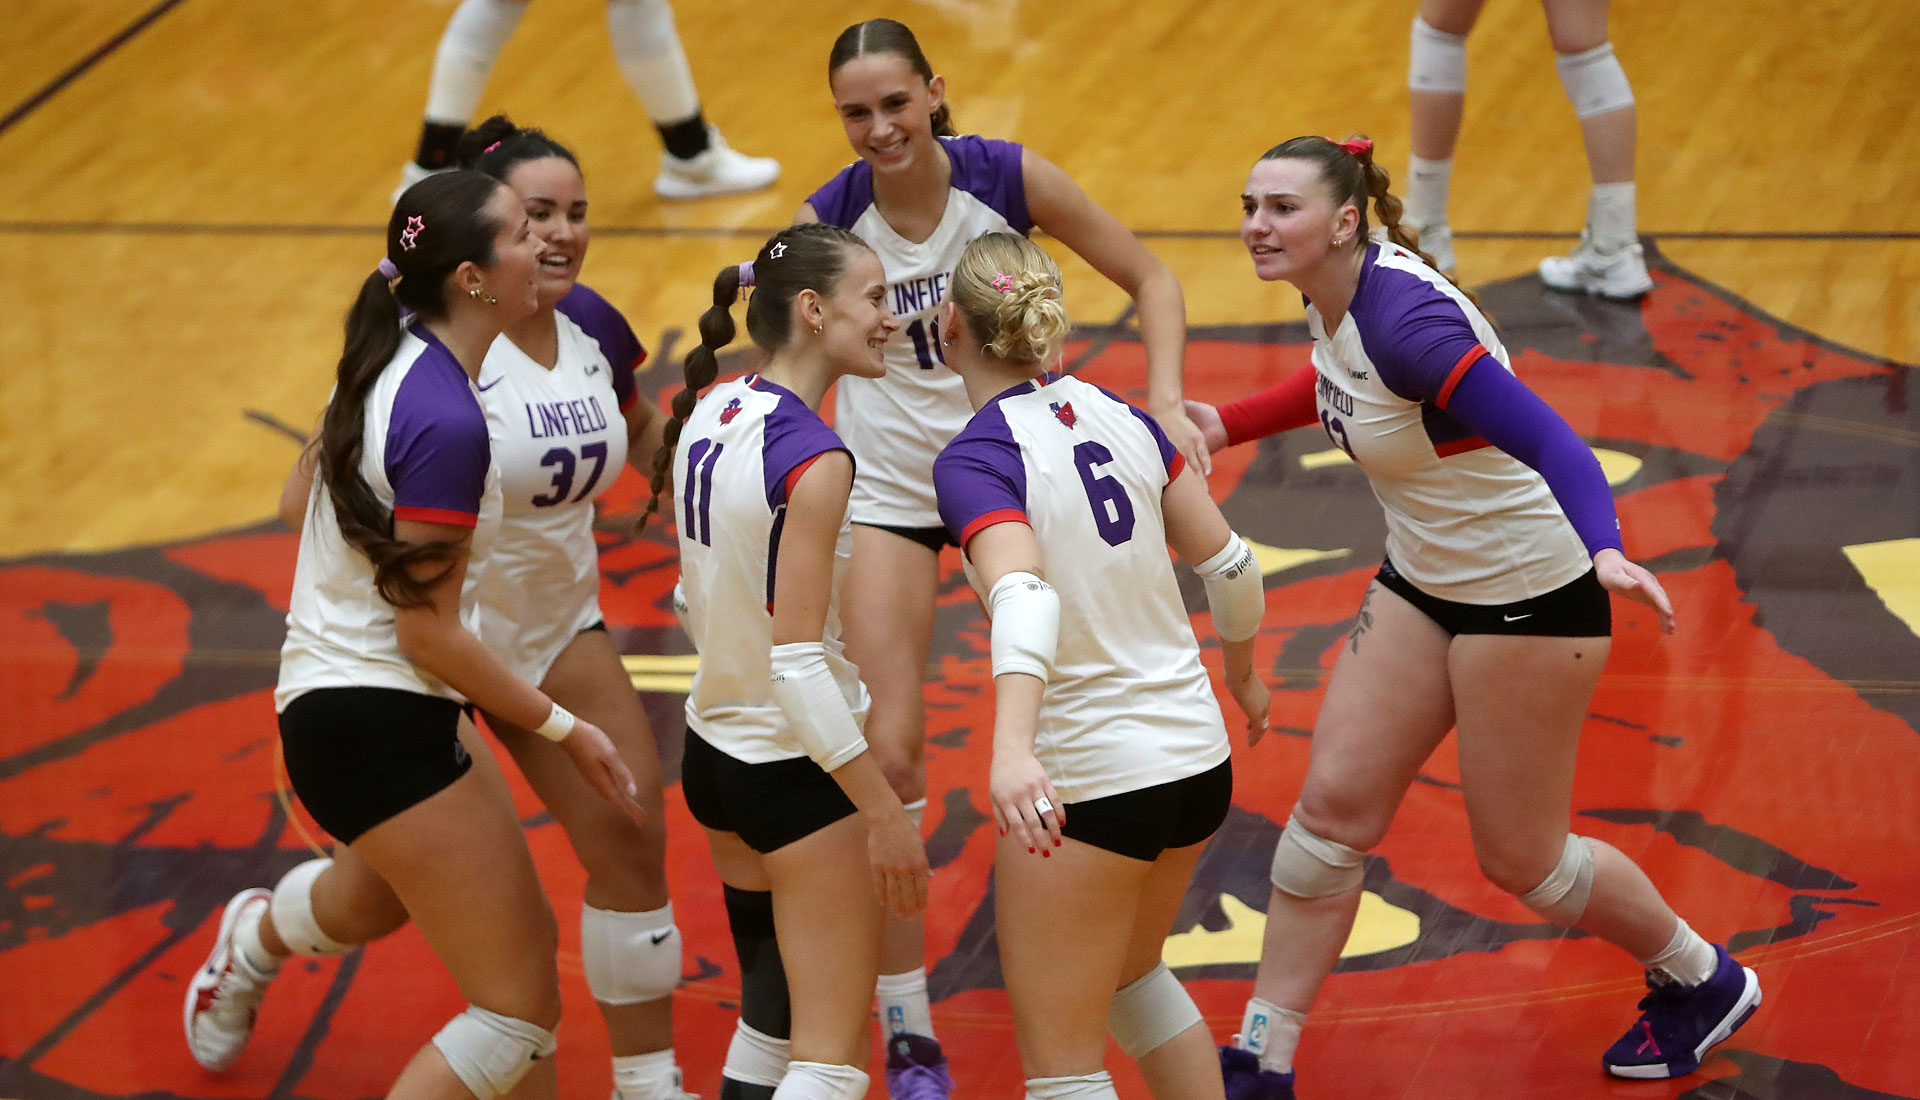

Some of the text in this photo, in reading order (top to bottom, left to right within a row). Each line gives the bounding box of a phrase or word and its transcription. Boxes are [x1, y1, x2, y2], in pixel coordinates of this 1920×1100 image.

[892, 271, 951, 316] INFIE
[525, 395, 608, 438] LINFIELD
[531, 440, 609, 508] 37
[684, 437, 724, 548] 11
[1073, 440, 1136, 548] 6
